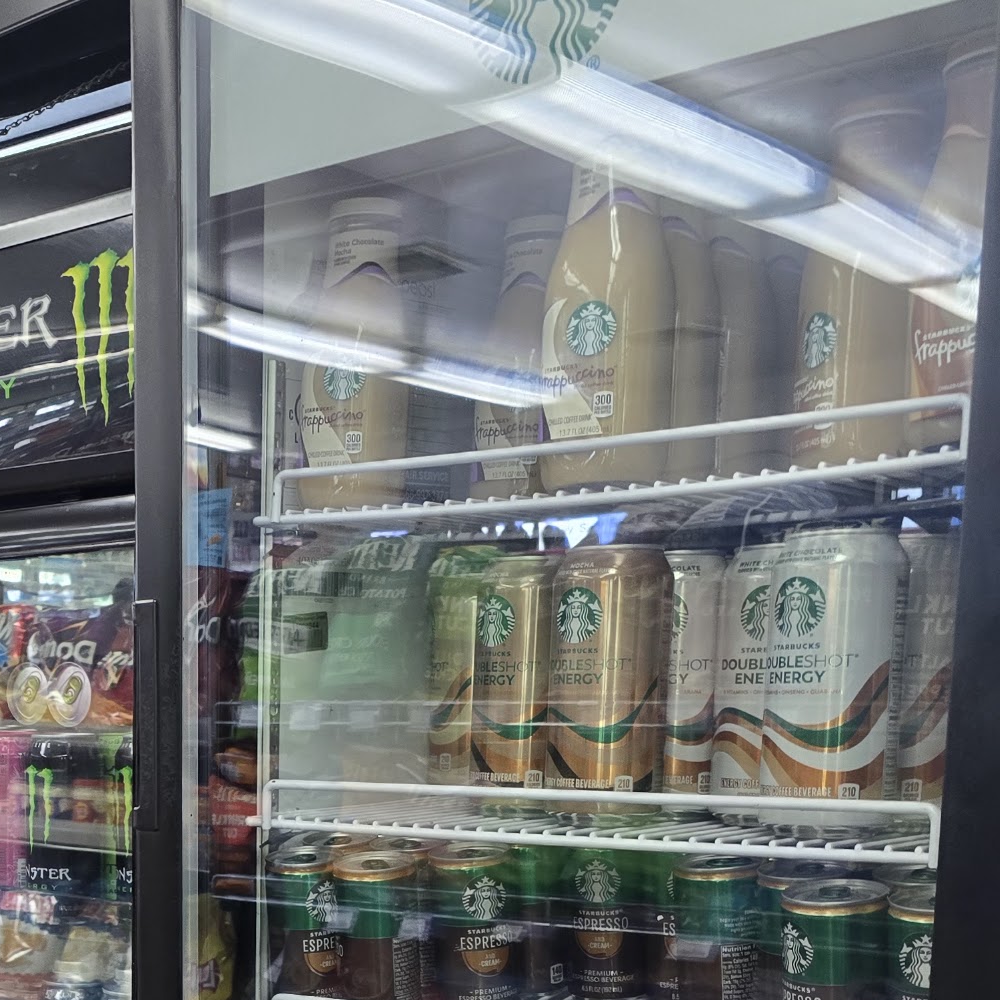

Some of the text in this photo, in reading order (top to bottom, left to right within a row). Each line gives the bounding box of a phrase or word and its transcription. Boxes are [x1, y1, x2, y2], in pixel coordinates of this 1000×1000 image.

[351, 239, 384, 247] Chocolate
[914, 328, 977, 368] frappuc
[595, 394, 612, 405] 300
[302, 404, 364, 434] frappuccino
[475, 416, 539, 446] frappuccino
[346, 433, 361, 443] 300
[794, 547, 843, 558] CHOCOLATE
[739, 559, 761, 568] WHITE
[557, 647, 599, 655] STARBUCKS
[773, 642, 821, 651] STARBUCKS
[722, 658, 767, 671] DOUBL
[553, 673, 604, 685] ENERGY
[735, 672, 765, 685] ENE
[769, 671, 826, 685] ENERGY
[491, 772, 521, 783] BEVERAGE
[527, 772, 540, 782] 210
[557, 778, 611, 789] COFFEE BEVERAGE
[618, 779, 630, 789] 210
[905, 781, 920, 793] 210
[772, 785, 831, 798] COFFEE BEVERAGE
[842, 786, 857, 798] 210
[26, 864, 72, 881] NSTER
[574, 916, 629, 930] ESPRESSO
[467, 923, 507, 935] STARBUCKS
[302, 936, 335, 953] ESPRE
[460, 930, 513, 951] ESPRESSO
[722, 945, 752, 953] Nutrition
[551, 964, 562, 974] 140
[601, 975, 634, 983] BEVERAGE
[474, 985, 508, 996] PREMIUM
